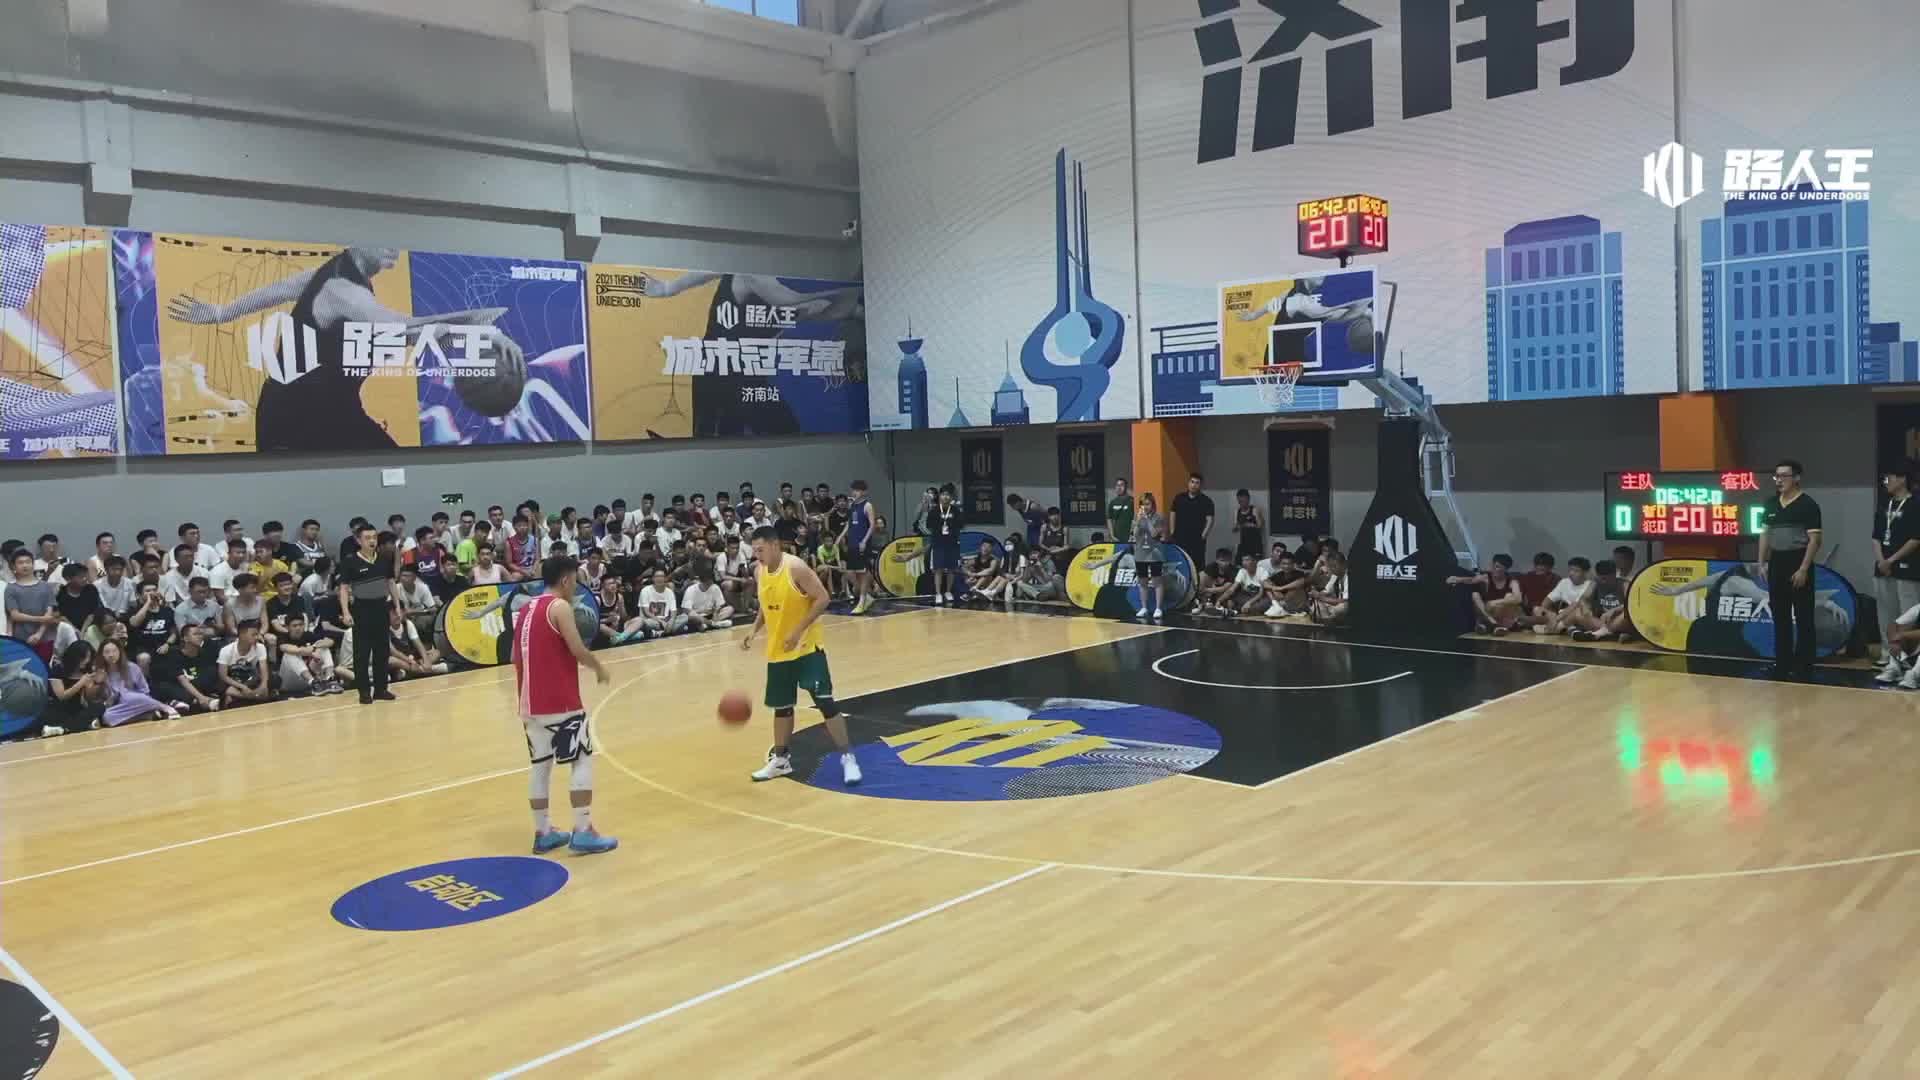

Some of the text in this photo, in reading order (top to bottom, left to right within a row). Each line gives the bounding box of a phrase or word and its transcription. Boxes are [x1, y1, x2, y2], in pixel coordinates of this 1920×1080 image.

[1309, 215, 1348, 249] 20
[1363, 214, 1384, 247] 20
[745, 304, 797, 324] 路人王
[342, 322, 497, 367] 路人王
[659, 336, 846, 377] 城市冠军赛
[343, 367, 369, 377] THE
[372, 367, 401, 377] KING
[425, 367, 496, 377] UNDERDOGS
[741, 386, 780, 402] 济南站
[1621, 472, 1656, 491] 主队
[1720, 472, 1760, 491] 客队
[1655, 488, 1723, 504] 06:42.0
[1615, 504, 1633, 532] 0
[1673, 506, 1706, 532] 20
[404, 875, 504, 912] 启动区
